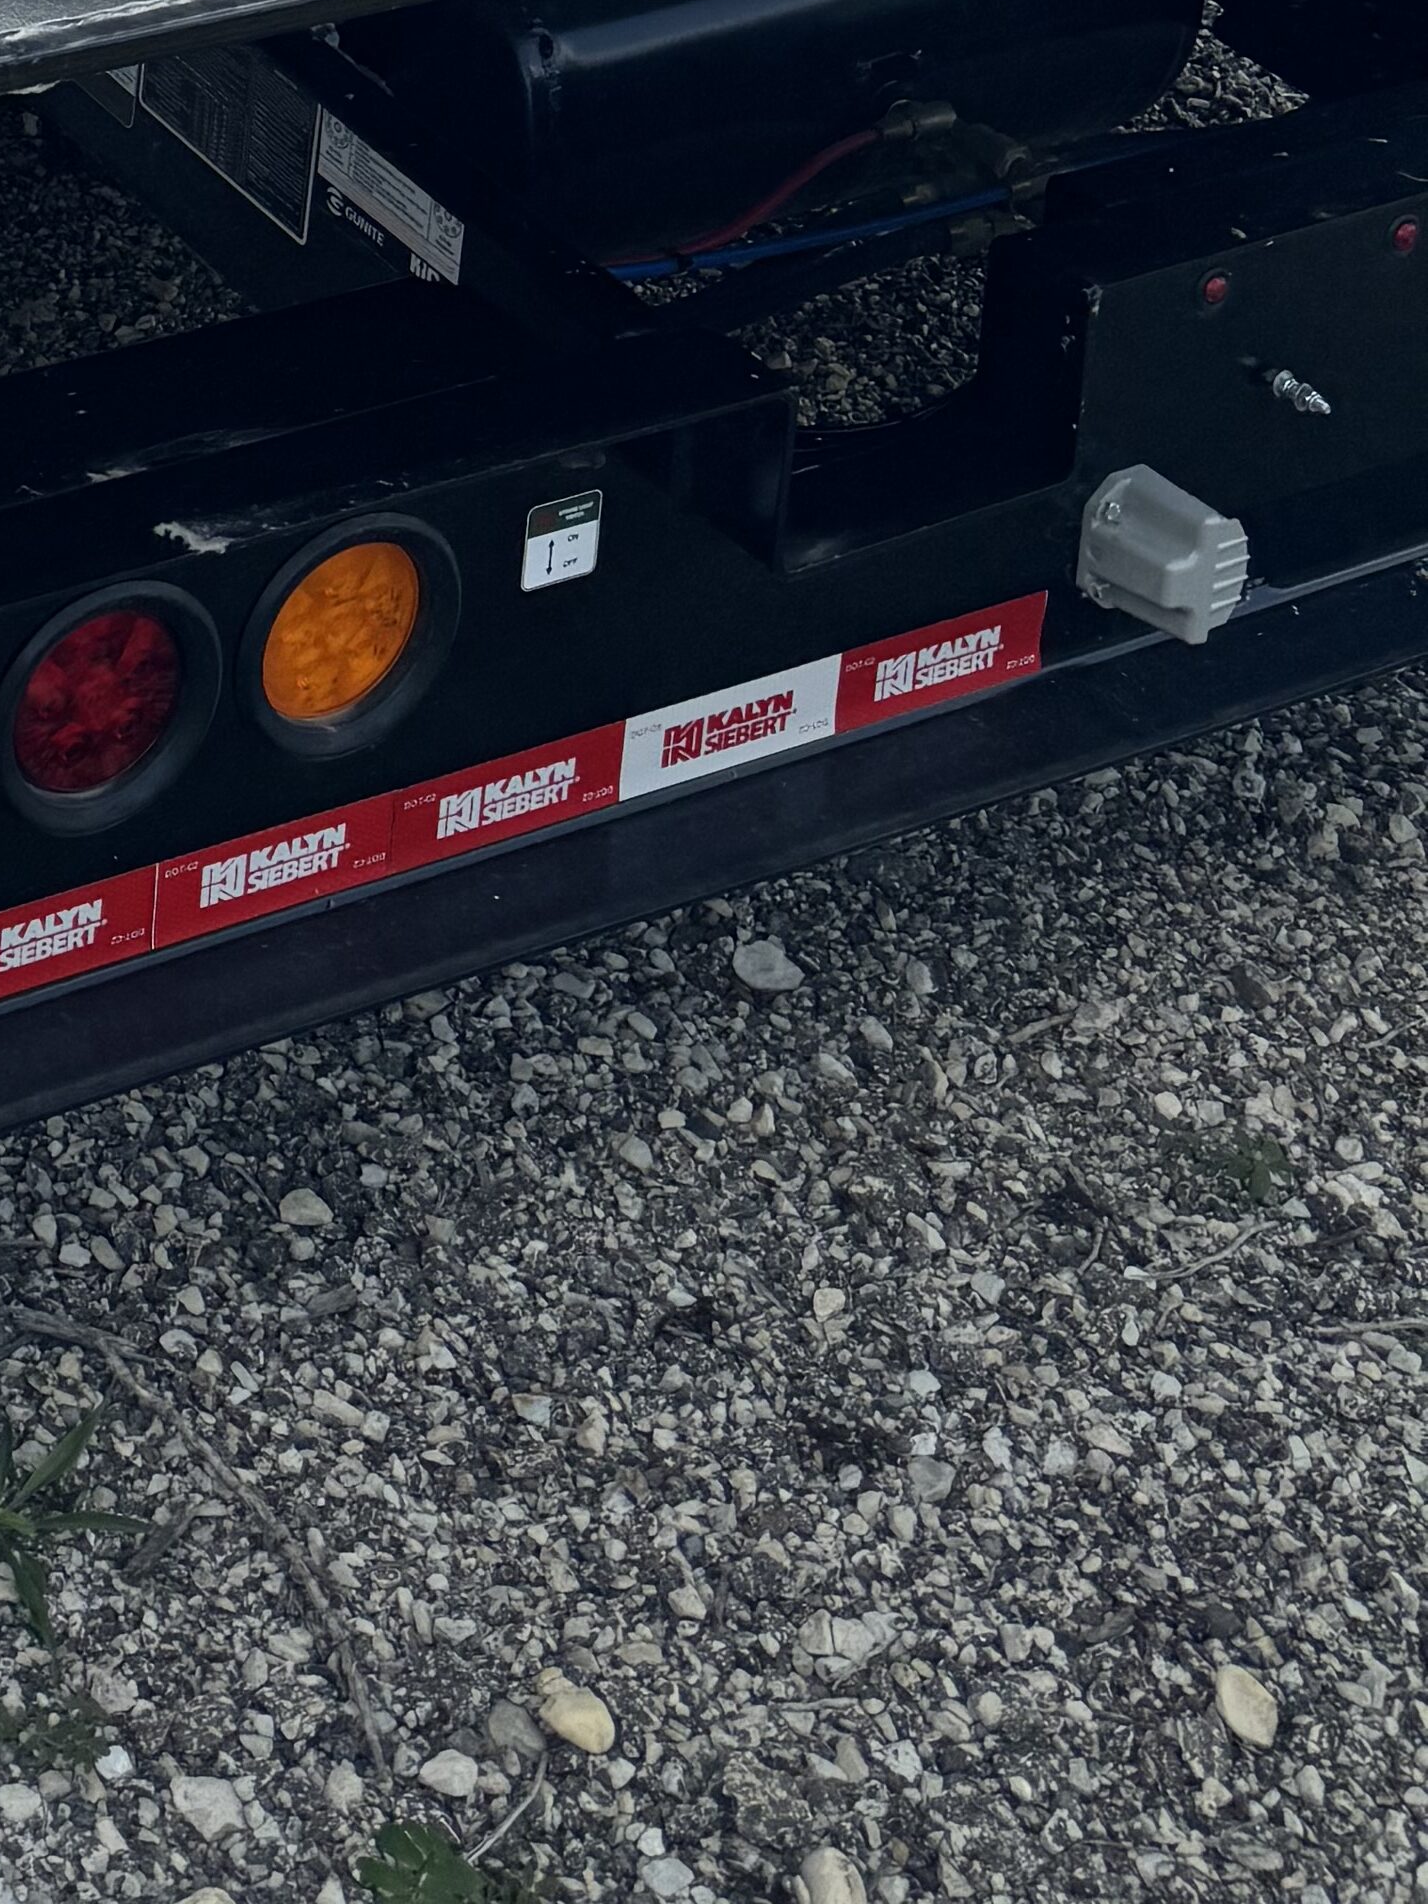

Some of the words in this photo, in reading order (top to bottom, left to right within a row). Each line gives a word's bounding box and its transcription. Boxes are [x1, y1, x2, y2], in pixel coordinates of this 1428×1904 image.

[345, 206, 385, 247] GUNITE
[914, 646, 999, 690] SIEBERT
[917, 624, 1002, 669] KALYN
[702, 711, 793, 757] SIEBERT
[705, 689, 795, 735] KALYN
[481, 780, 576, 826] SIEBERT
[483, 757, 577, 805] KALYN
[249, 822, 347, 871] KALYN
[246, 846, 345, 895] SIEBERT
[0, 898, 103, 951] KALYN
